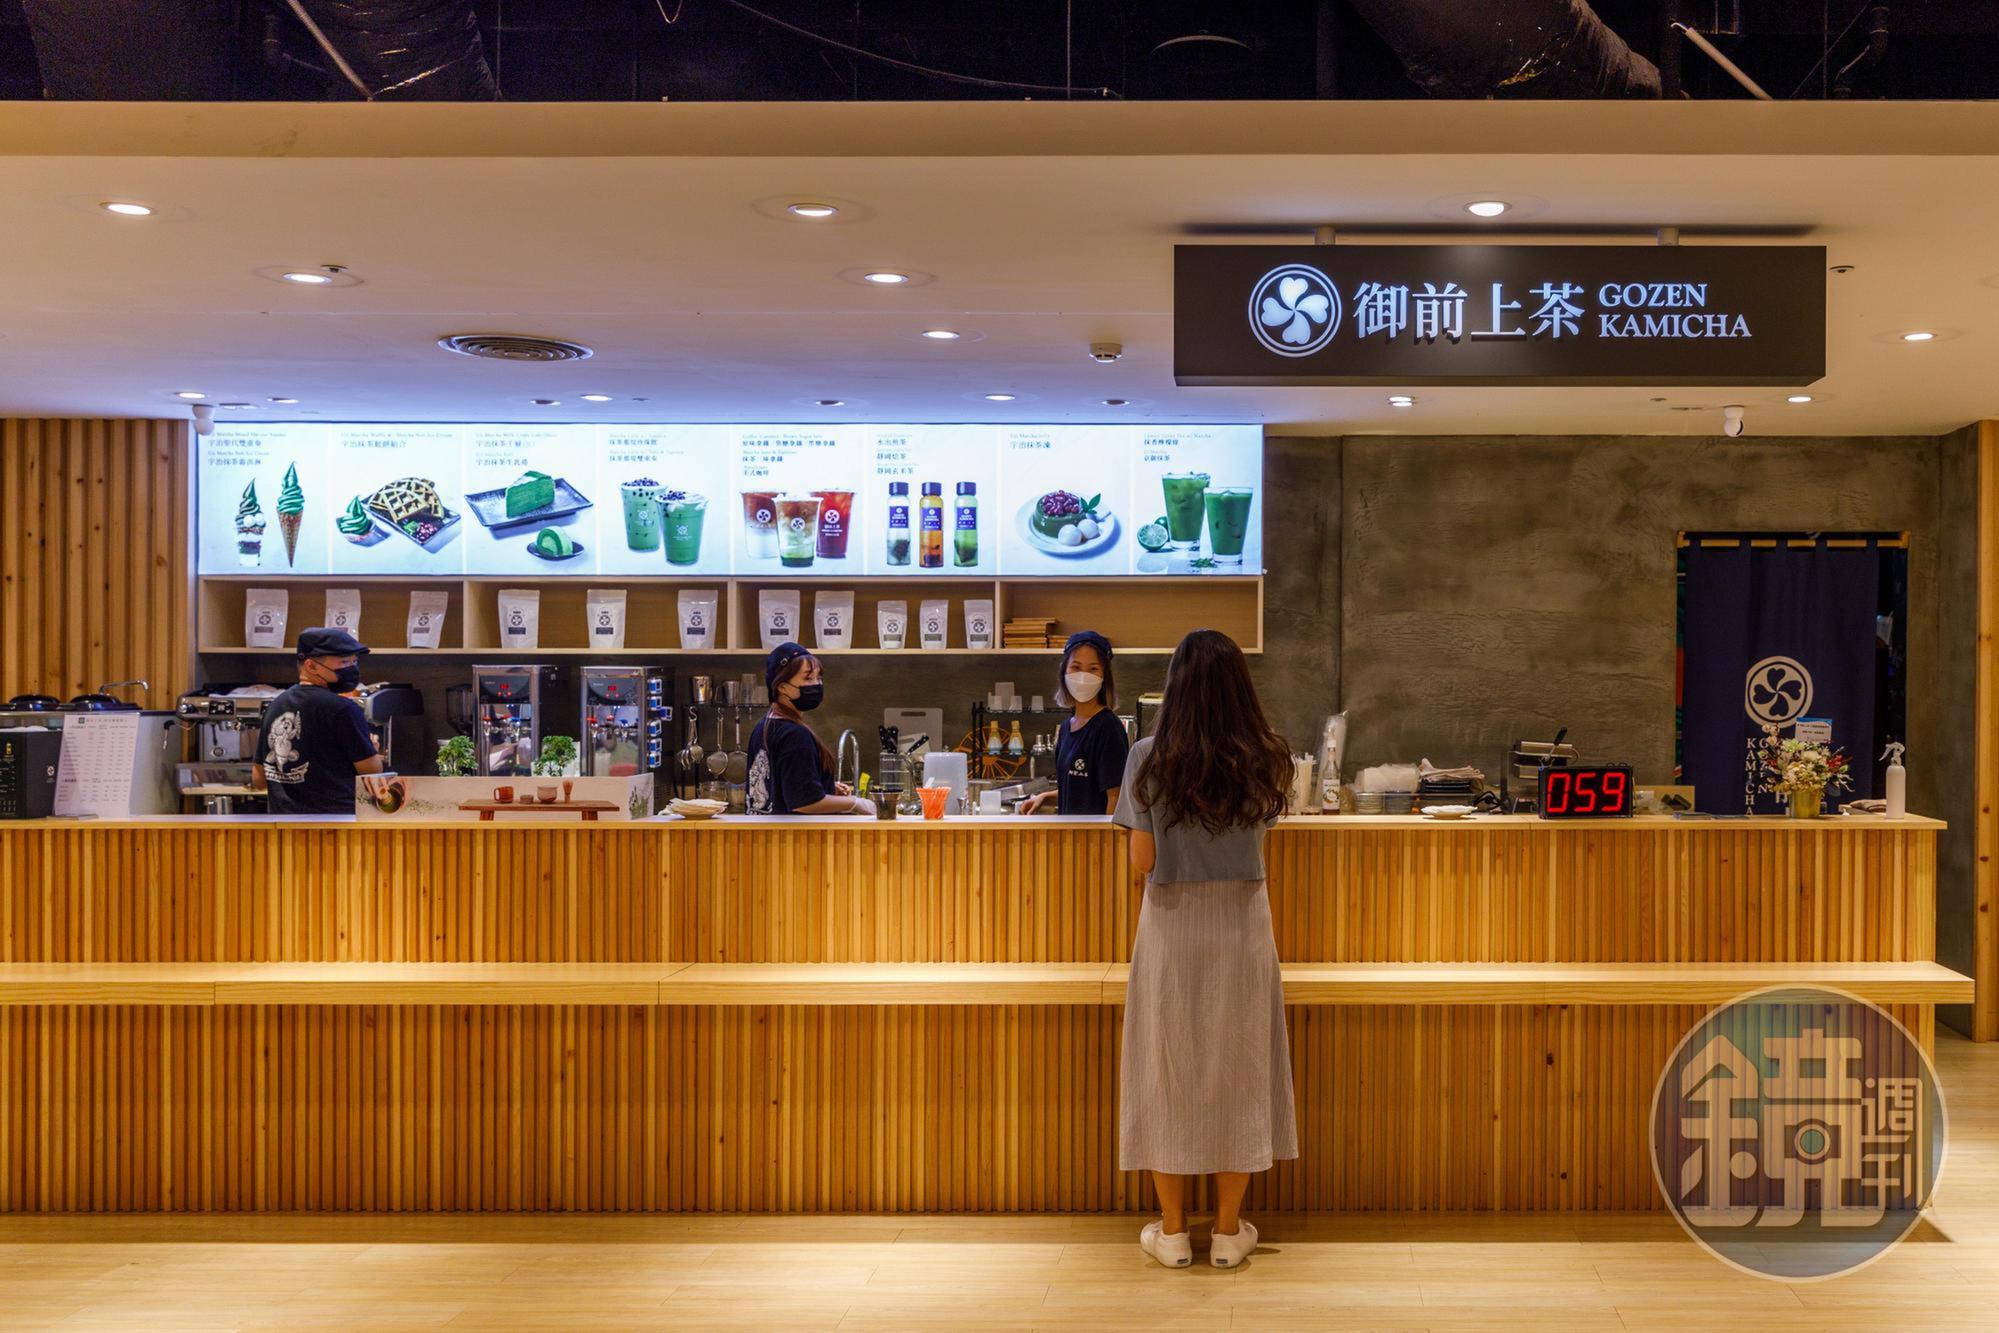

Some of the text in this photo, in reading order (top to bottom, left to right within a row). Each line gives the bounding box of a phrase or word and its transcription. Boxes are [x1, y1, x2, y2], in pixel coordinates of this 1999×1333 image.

[1353, 282, 1584, 340] 御前上茶
[1598, 282, 1708, 308] GOZEN
[1598, 313, 1753, 339] KAMICHA
[1547, 772, 1625, 813] 059
